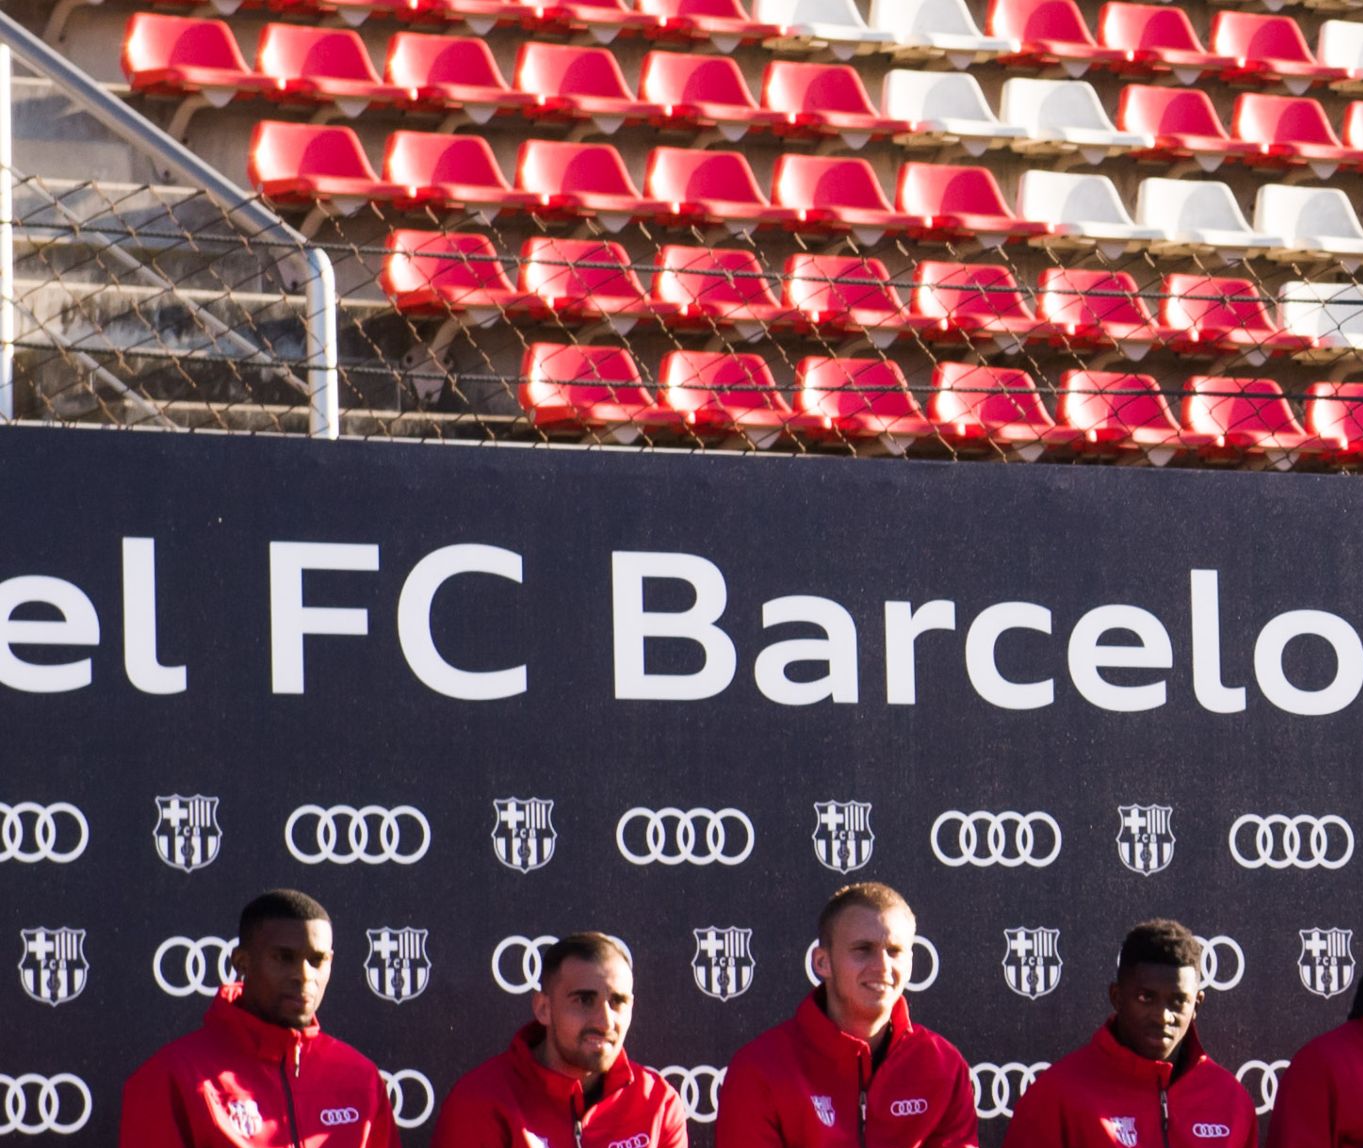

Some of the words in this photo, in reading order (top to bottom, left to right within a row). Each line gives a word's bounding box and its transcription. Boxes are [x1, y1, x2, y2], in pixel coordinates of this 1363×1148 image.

[0, 537, 188, 695] el
[269, 542, 528, 701] FC
[175, 826, 200, 836] FCB
[512, 829, 536, 838] FCB
[832, 830, 855, 840] FCB
[1135, 834, 1156, 843] FCB
[41, 959, 66, 969] FCB
[386, 959, 410, 968] FCB
[712, 957, 735, 966] FCB
[1021, 957, 1043, 966] FCB
[1316, 957, 1337, 966] FCB
